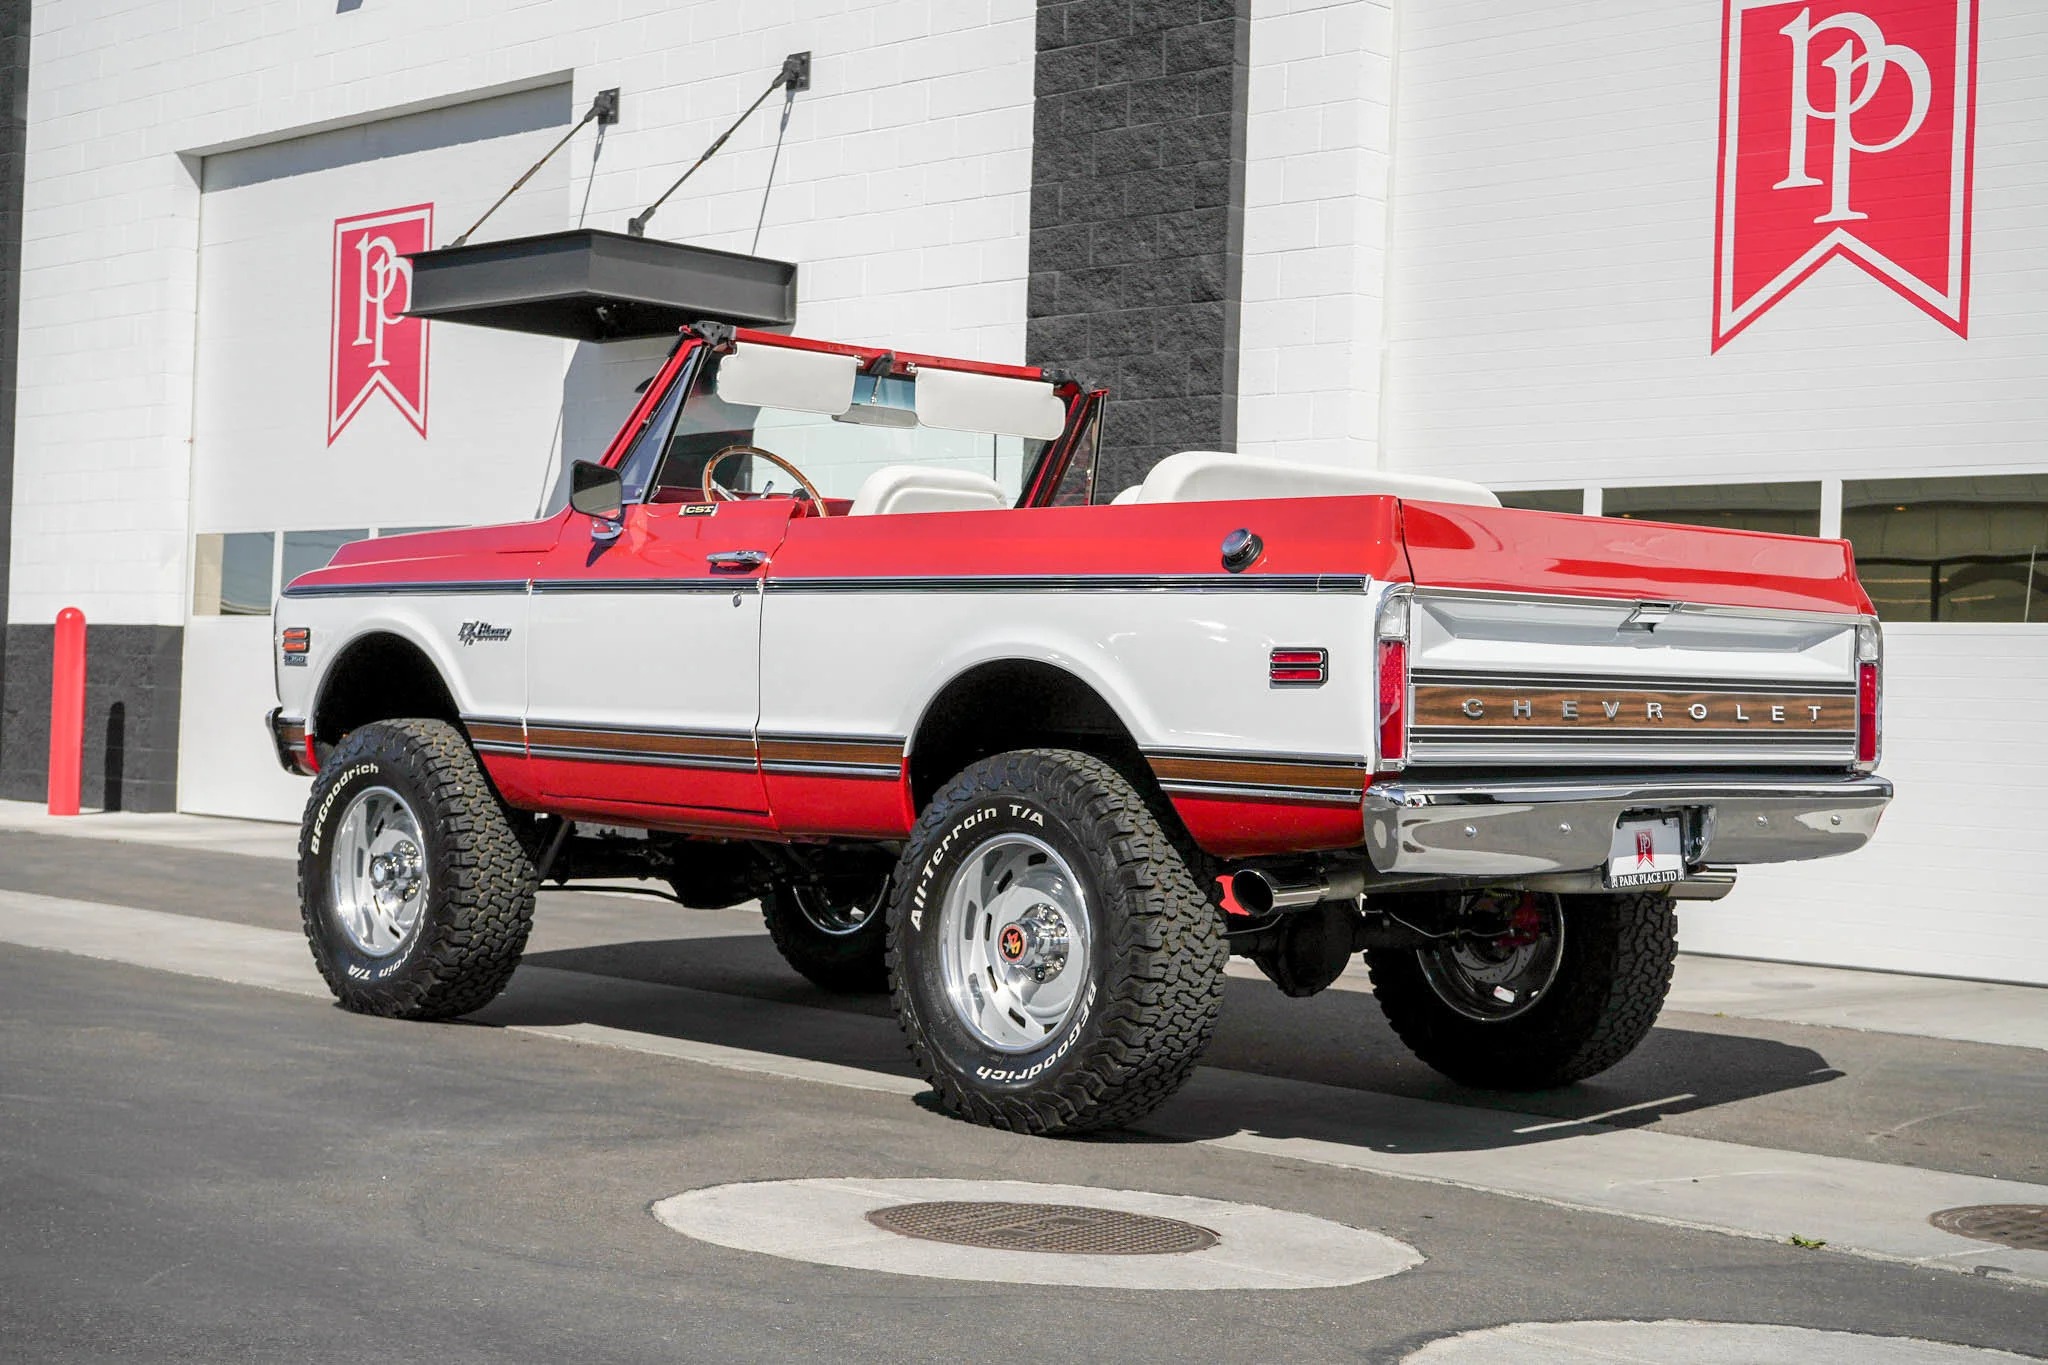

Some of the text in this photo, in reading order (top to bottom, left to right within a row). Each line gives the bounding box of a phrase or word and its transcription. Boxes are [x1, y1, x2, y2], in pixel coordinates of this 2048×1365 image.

[686, 505, 714, 514] CST
[1462, 698, 1821, 722] CHEVROLET
[310, 761, 379, 856] BFGoodrich
[910, 804, 1044, 932] All-Terrain T/A
[1620, 874, 1639, 887] PARK
[1639, 872, 1660, 885] PLACE
[1662, 870, 1677, 883] LTD
[347, 964, 371, 980] T/A
[976, 981, 1097, 1084] BFGoodrich
